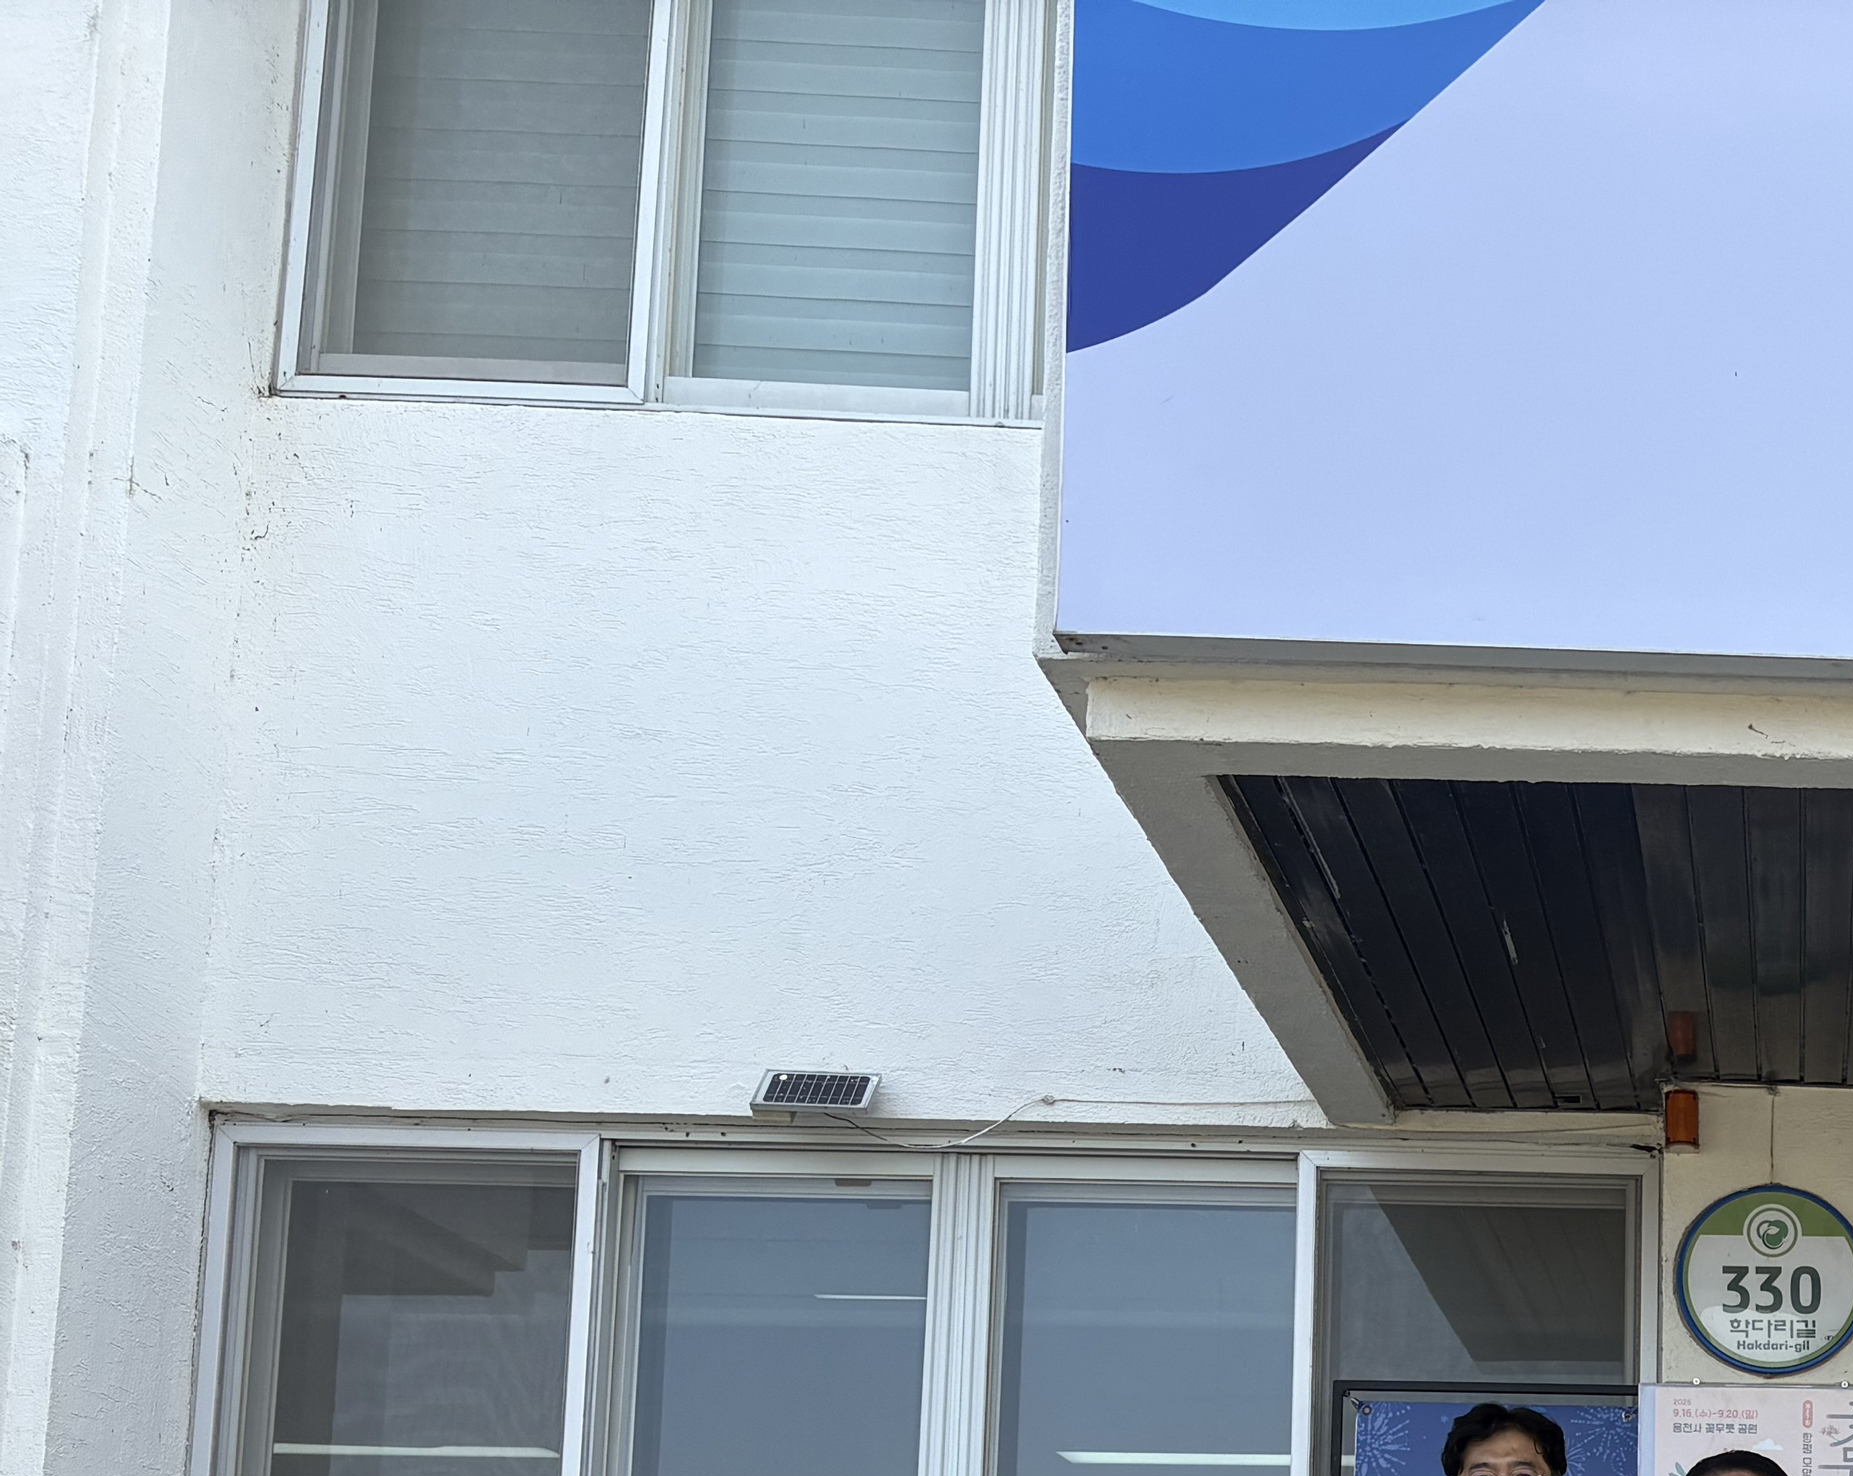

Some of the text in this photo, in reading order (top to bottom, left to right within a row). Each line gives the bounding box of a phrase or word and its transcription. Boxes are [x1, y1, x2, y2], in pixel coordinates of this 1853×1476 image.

[1722, 1265, 1822, 1314] 330
[1730, 1319, 1816, 1339] 학다리길
[1737, 1340, 1810, 1352] Hakdari-gil
